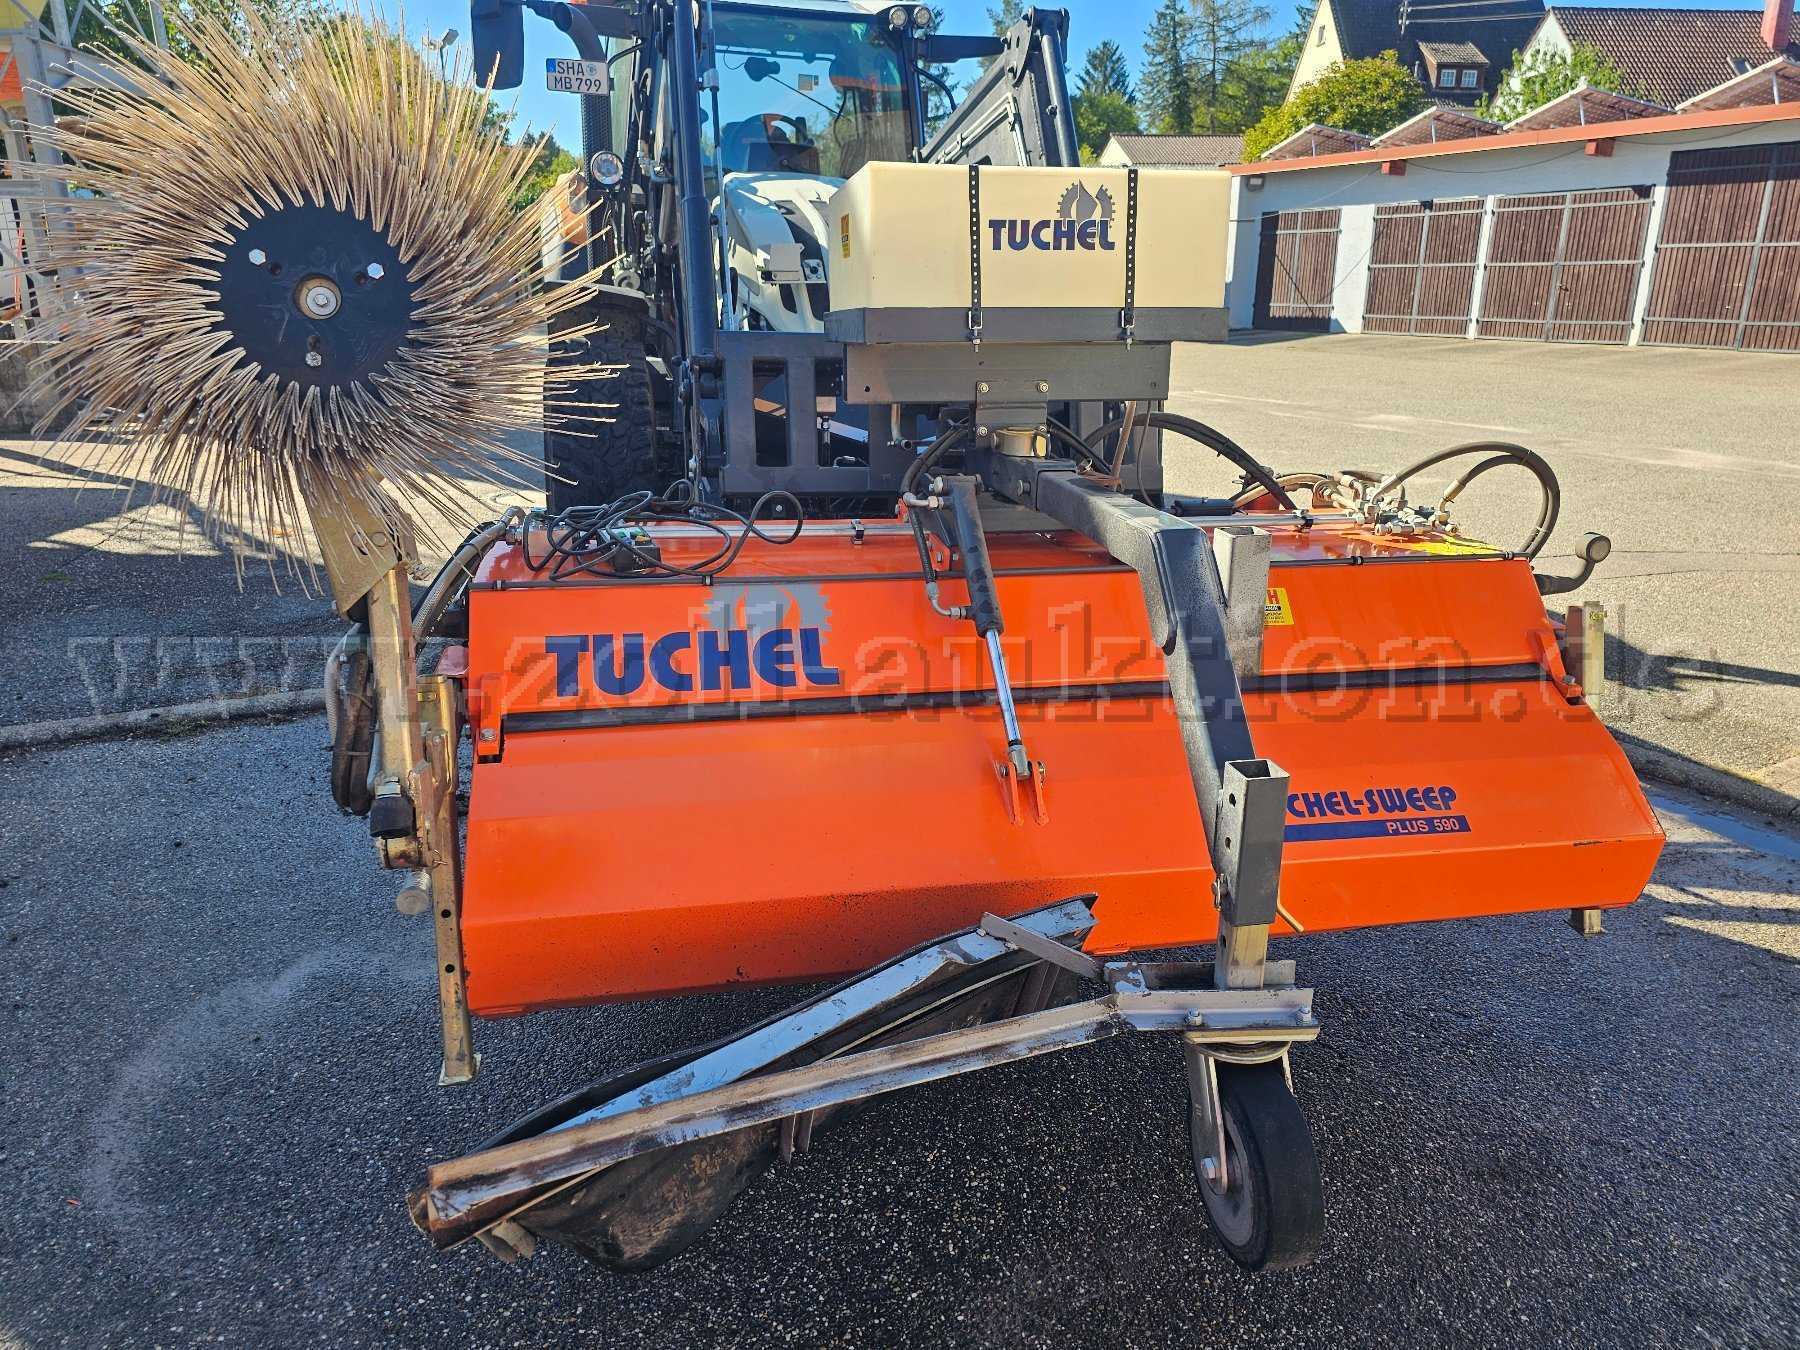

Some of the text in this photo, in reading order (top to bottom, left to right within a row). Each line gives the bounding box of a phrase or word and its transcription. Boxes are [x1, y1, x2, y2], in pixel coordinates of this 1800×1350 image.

[557, 62, 585, 76] SHA
[554, 76, 602, 92] MB 799
[988, 218, 1115, 251] TUCHEL
[544, 626, 841, 698] TUCHEL
[1286, 785, 1457, 818] CHEL-SWEEP
[1386, 818, 1459, 834] PLUS 590
